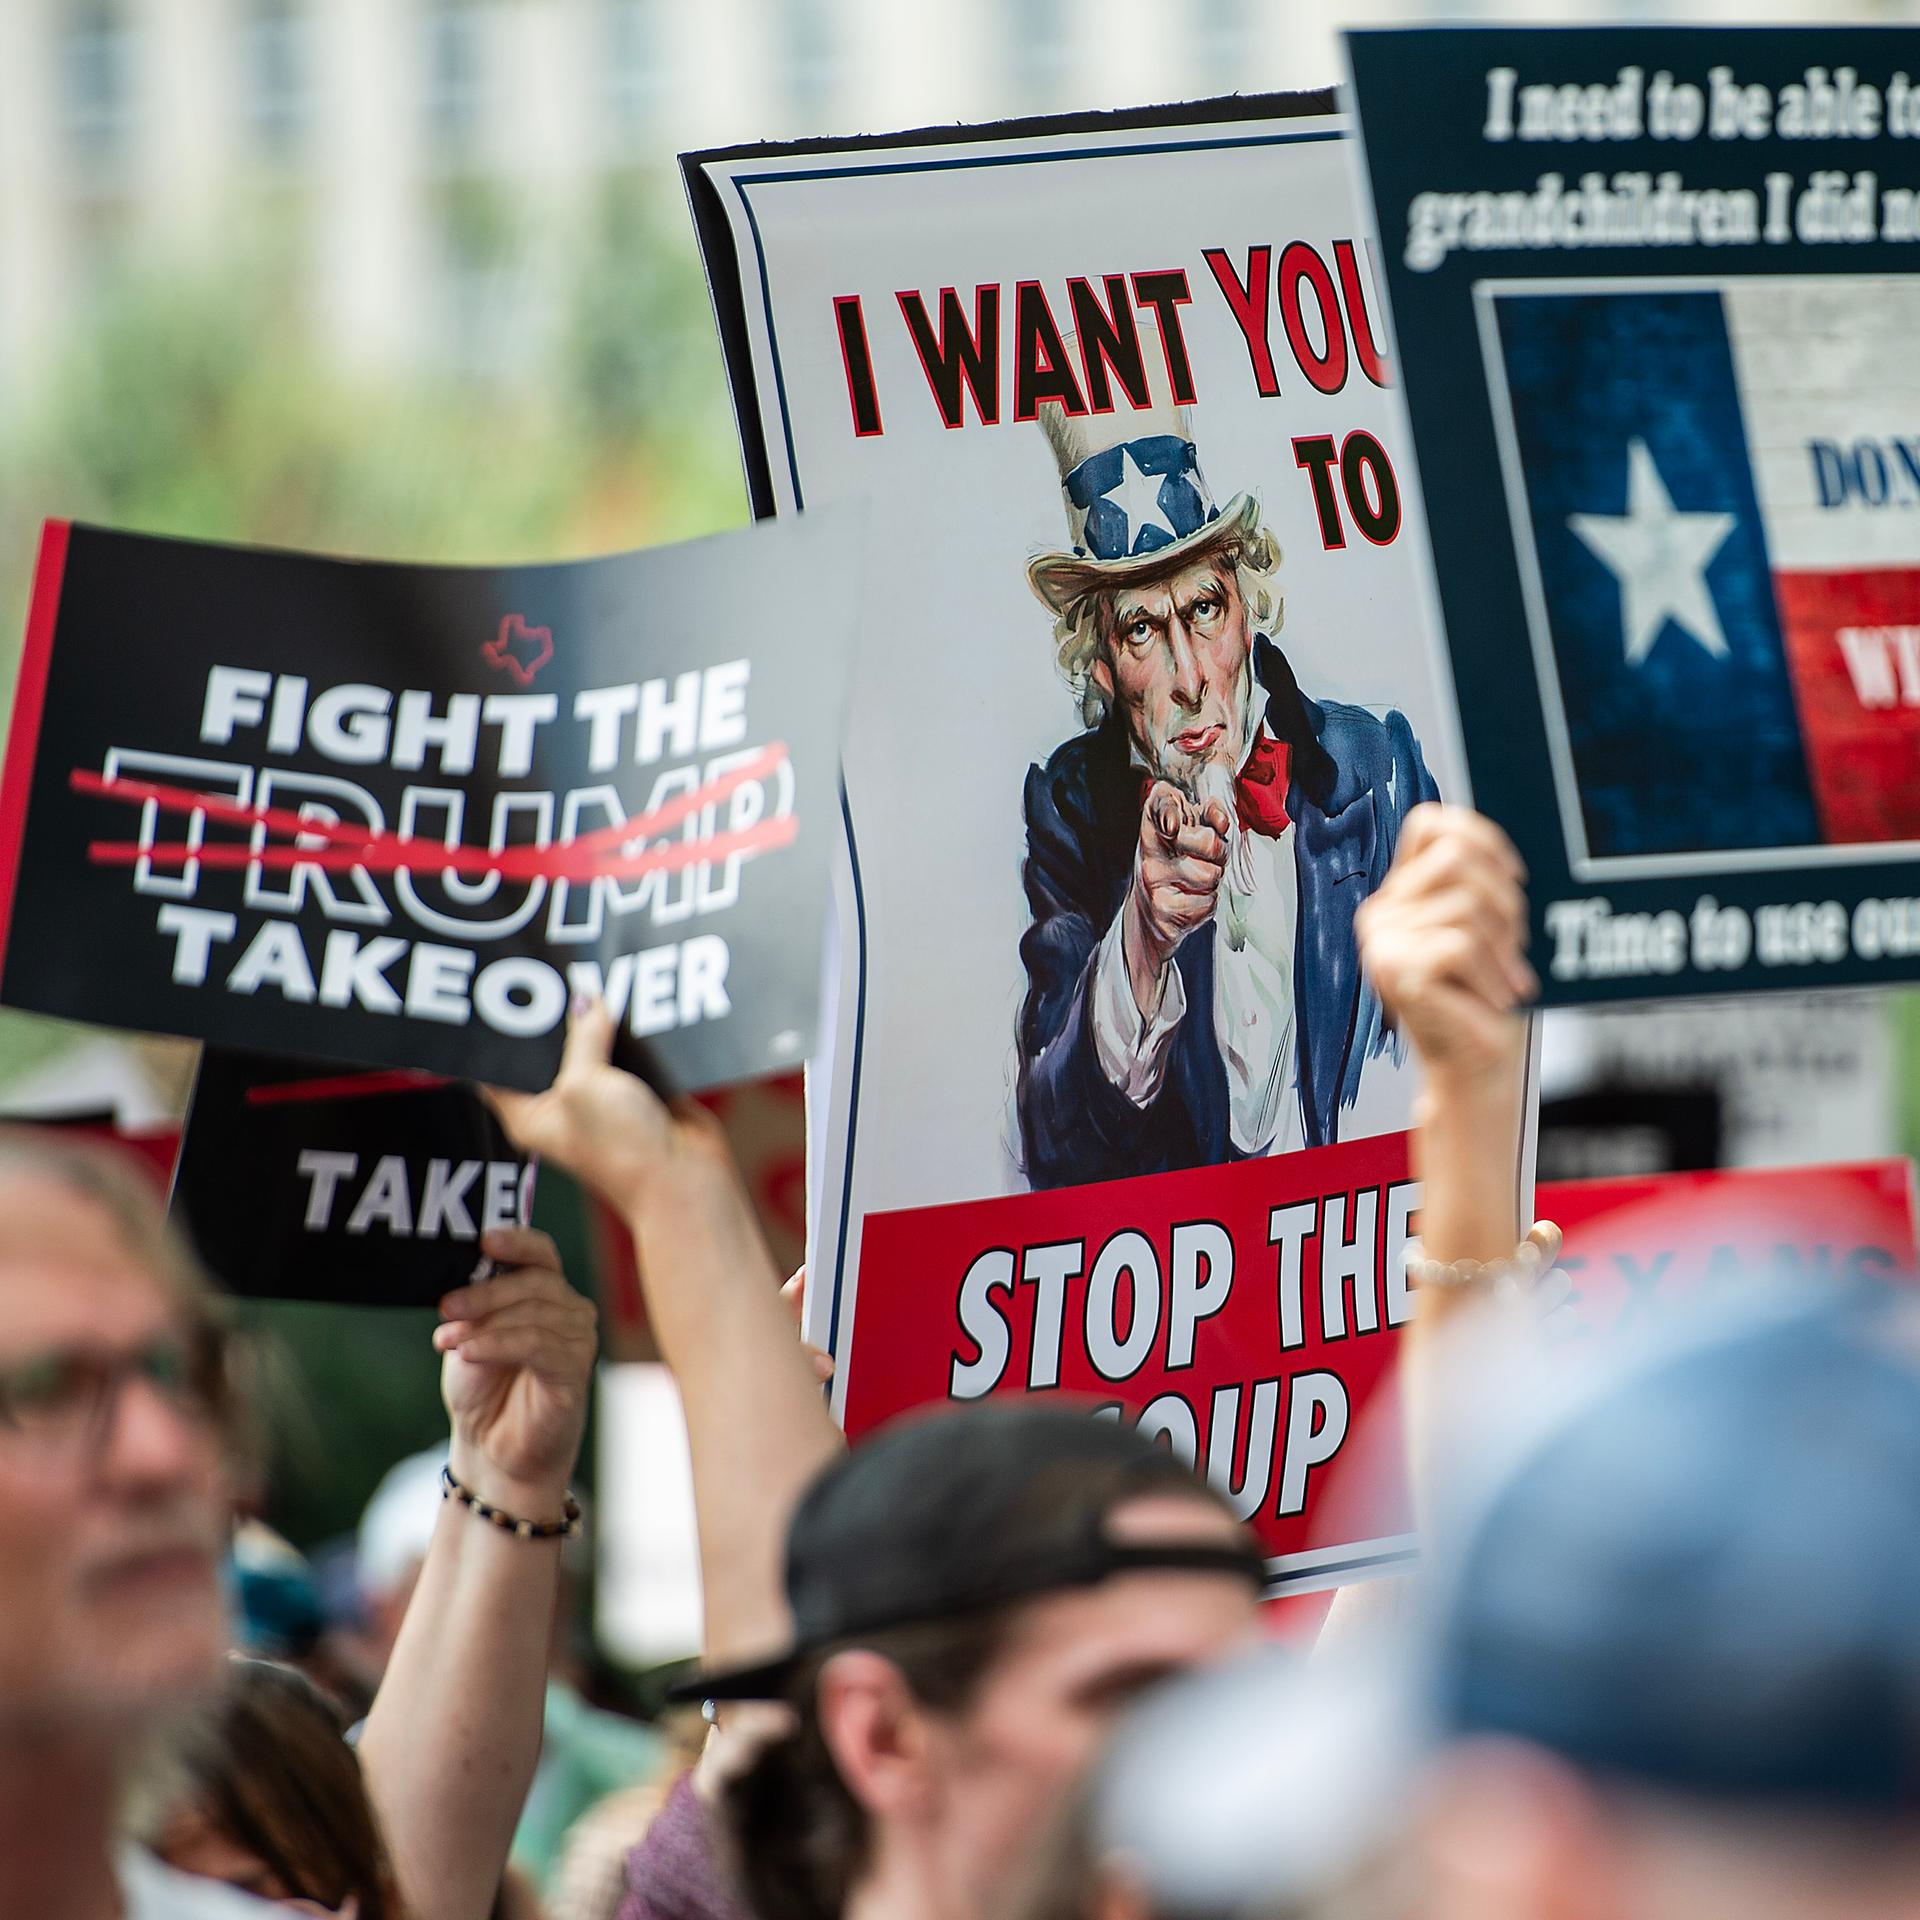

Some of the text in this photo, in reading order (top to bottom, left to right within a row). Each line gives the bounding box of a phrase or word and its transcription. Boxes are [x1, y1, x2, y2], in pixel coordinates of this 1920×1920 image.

[1518, 65, 1645, 141] need
[1647, 69, 1703, 139] to
[1708, 66, 1772, 139] be
[1776, 65, 1882, 139] able
[1403, 171, 1760, 272] grandchildren
[1797, 170, 1878, 243] did
[832, 294, 884, 438] I
[894, 267, 1198, 430] WANT
[1290, 429, 1402, 551] TO
[200, 658, 751, 778] FIGHT THE
[103, 744, 796, 945] TRUMP
[156, 903, 732, 1039] TAKEOVER
[1545, 897, 1689, 981] Time
[1690, 894, 1752, 971] to
[1755, 899, 1849, 964] use
[948, 1178, 1424, 1400] STOP THE
[1086, 1367, 1350, 1524] OUP
